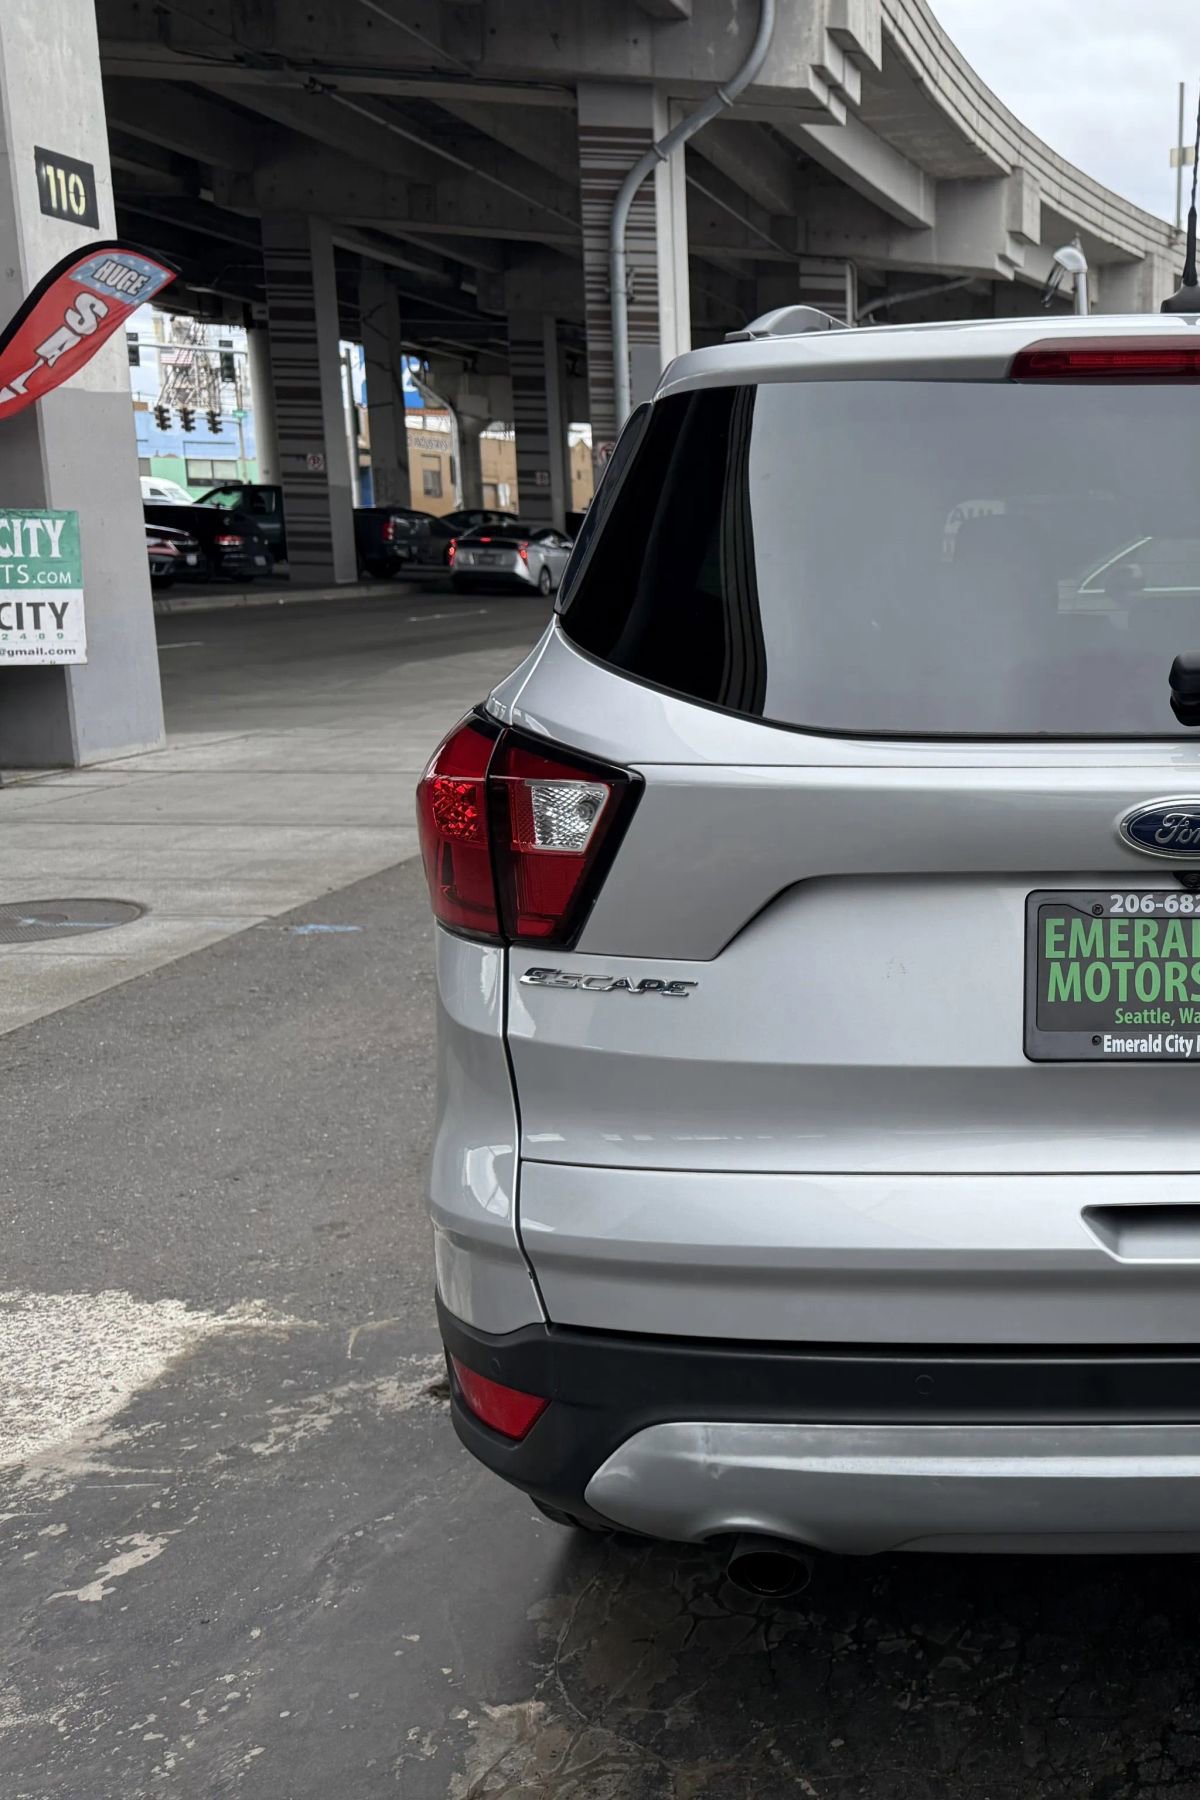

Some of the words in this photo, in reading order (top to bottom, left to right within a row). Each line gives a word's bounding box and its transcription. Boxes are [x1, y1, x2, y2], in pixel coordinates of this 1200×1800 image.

[45, 165, 86, 216] 110
[92, 258, 151, 296] HUGE
[0, 291, 109, 402] SAL
[0, 518, 65, 558] CITY
[0, 602, 69, 630] CITY
[520, 967, 699, 997] ESCAPE
[1114, 1007, 1176, 1026] Seattle,
[1103, 1034, 1161, 1053] Emerald
[1164, 1034, 1197, 1058] City
